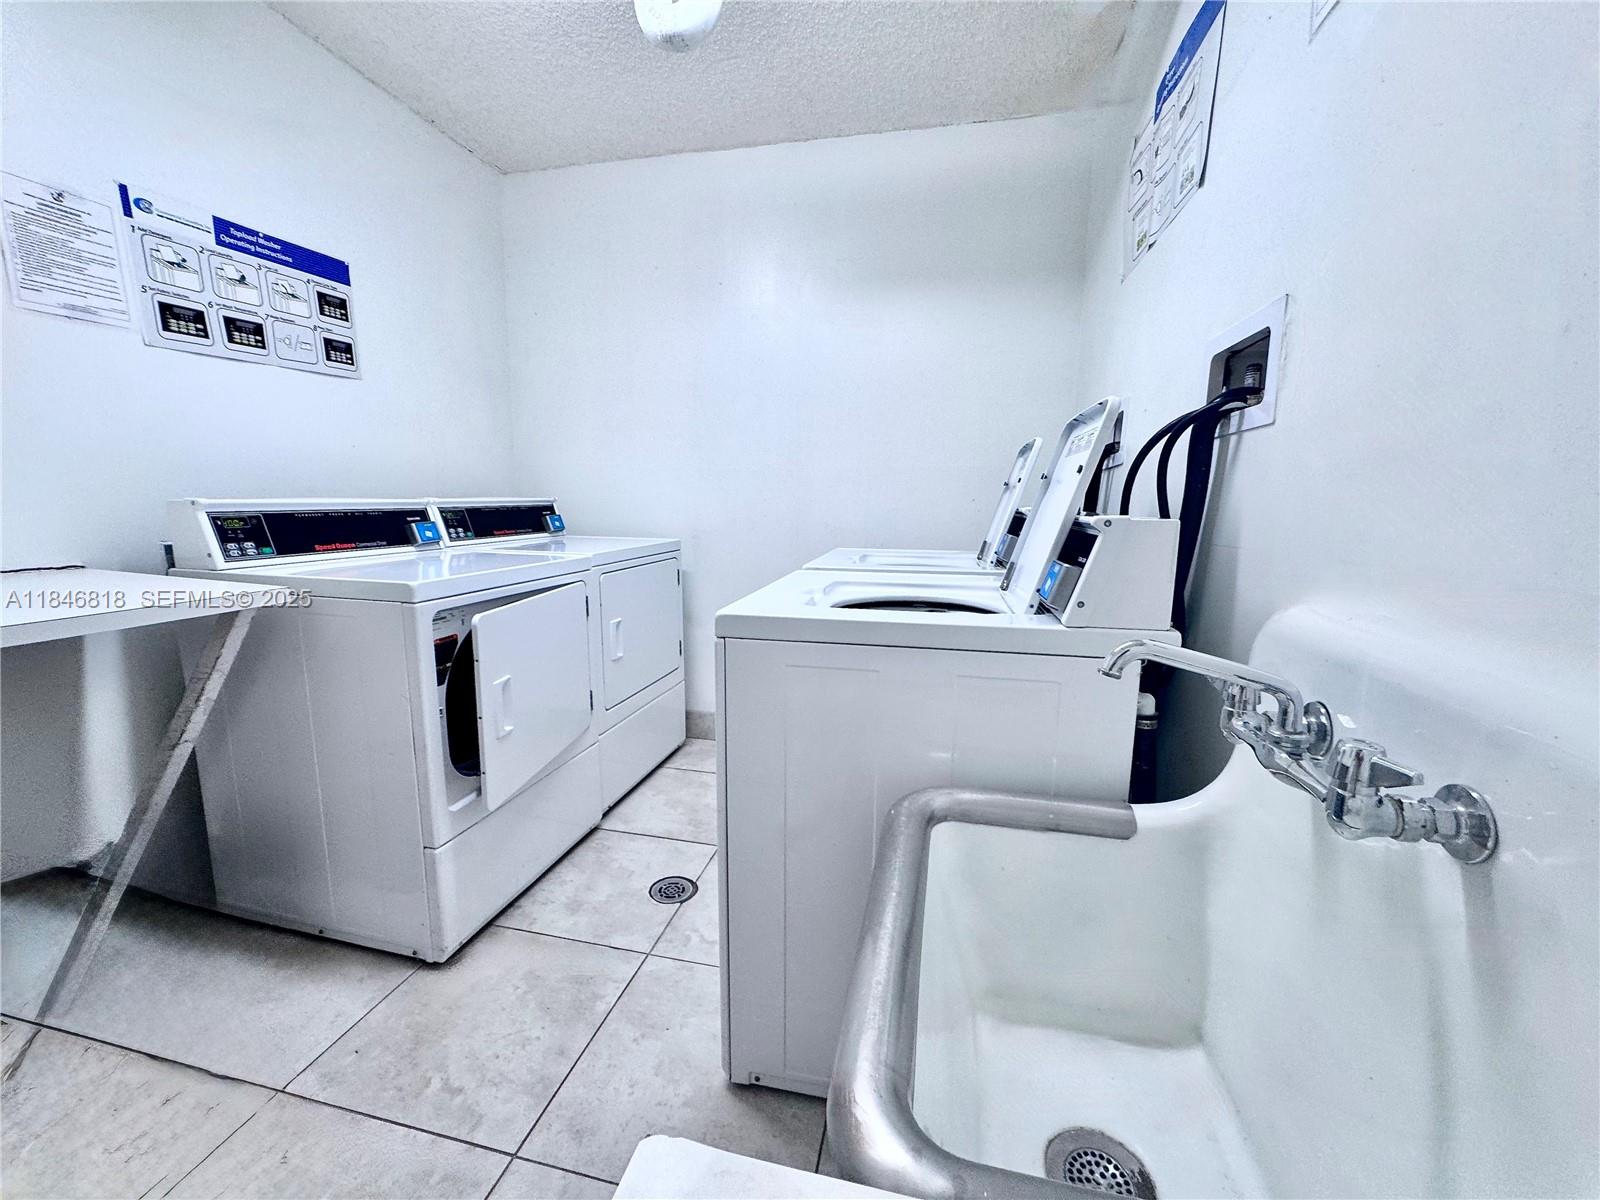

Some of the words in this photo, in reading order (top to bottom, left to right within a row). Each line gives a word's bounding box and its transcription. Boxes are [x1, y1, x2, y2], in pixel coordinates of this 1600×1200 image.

[229, 227, 256, 242] Topload
[257, 237, 281, 250] Washer
[199, 245, 205, 255] 2
[220, 234, 255, 251] Operating
[255, 245, 293, 262] Instructions
[141, 285, 148, 293] 5
[208, 301, 214, 309] 6
[314, 543, 336, 551] Speed
